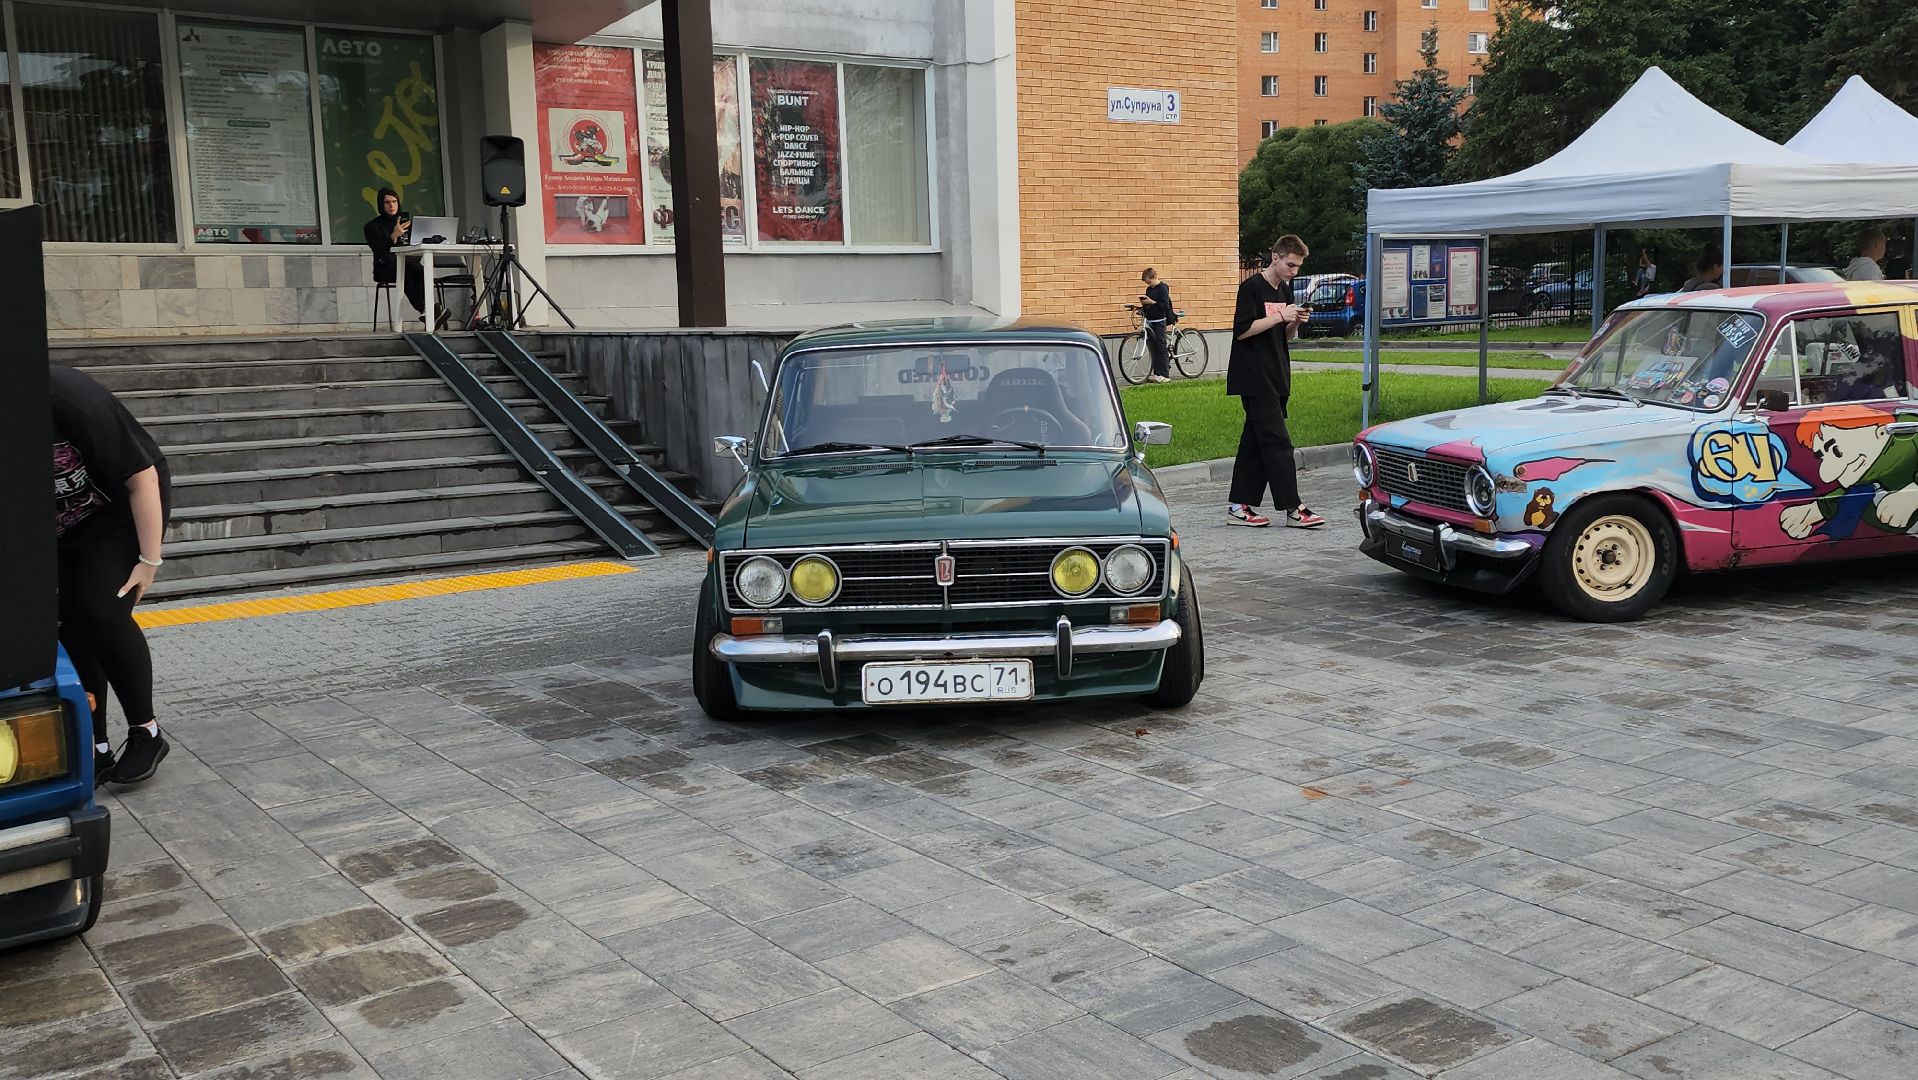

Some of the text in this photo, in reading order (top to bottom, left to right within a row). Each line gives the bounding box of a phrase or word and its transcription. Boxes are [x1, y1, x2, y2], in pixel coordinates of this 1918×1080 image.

[777, 95, 809, 106] BUNT
[1167, 94, 1175, 111] 3
[780, 124, 810, 132] HIP-HOP
[771, 132, 819, 142] K-POP COVER
[784, 141, 808, 150] DANCE
[777, 150, 815, 159] JAZZ-FUNK
[780, 167, 815, 176] БАЛЬНЫЕ
[783, 176, 810, 185] ТАНЦЫ
[772, 206, 825, 214] LETS DANCE
[994, 667, 1018, 686] 71
